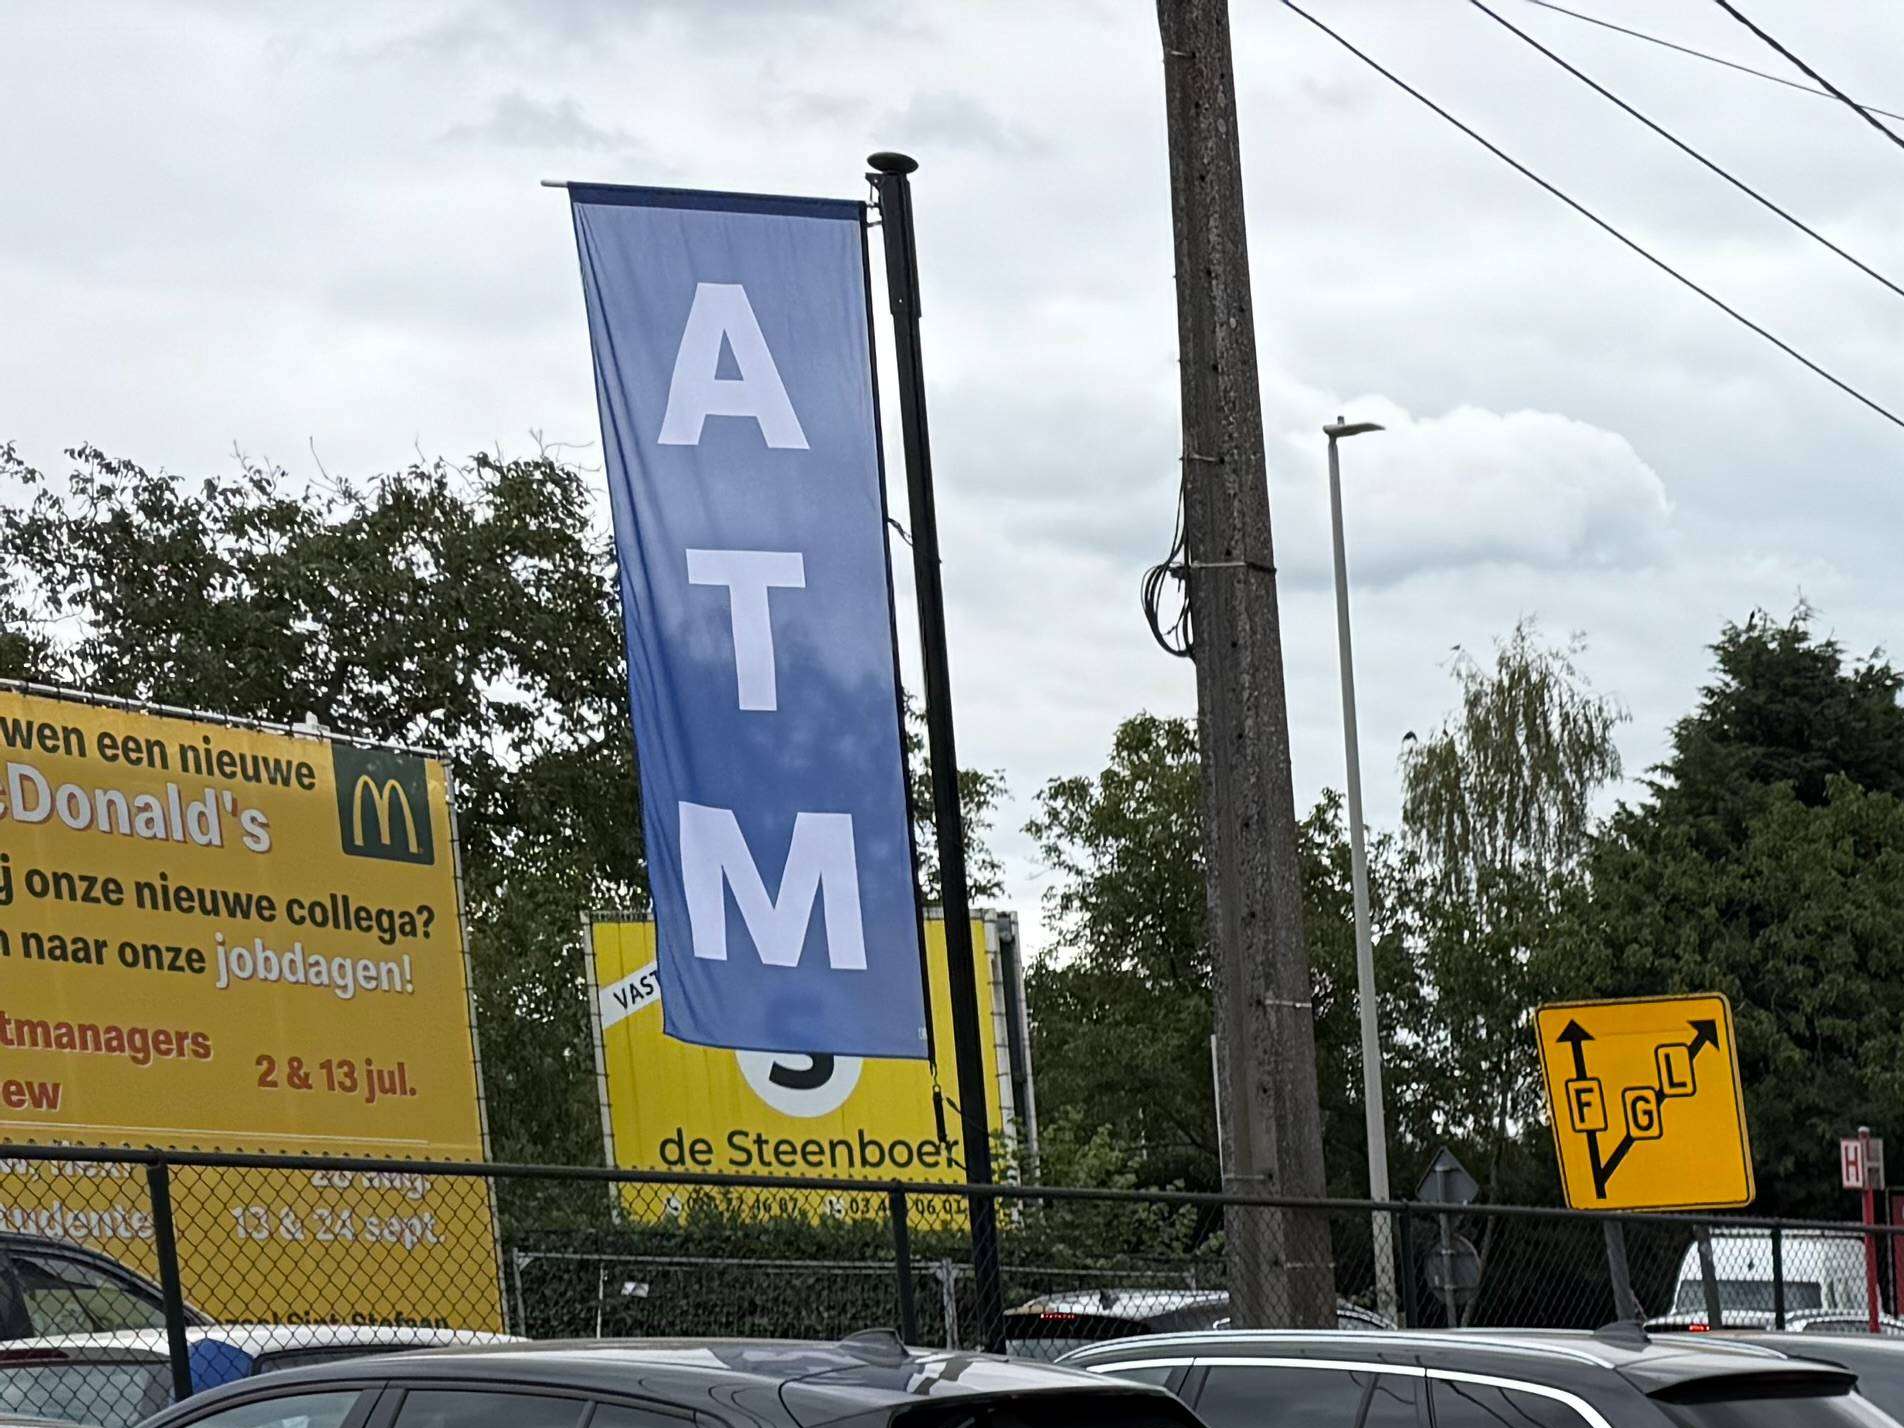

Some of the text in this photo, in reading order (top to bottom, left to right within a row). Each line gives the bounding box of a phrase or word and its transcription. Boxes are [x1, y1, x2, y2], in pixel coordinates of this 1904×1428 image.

[97, 730, 168, 771] een
[179, 735, 317, 792] nieuwe
[0, 760, 272, 855] Donald's
[24, 867, 125, 907] onze
[134, 872, 278, 924] nieuwe
[286, 893, 436, 946] collega?
[22, 930, 108, 965] naar
[117, 942, 207, 975] onze
[214, 931, 416, 1001] jobdagen!
[255, 1054, 279, 1090] 2
[286, 1056, 313, 1091] &
[319, 1058, 358, 1094] 13
[363, 1057, 418, 1105] jul.
[1664, 1053, 1687, 1089] L
[1574, 1087, 1594, 1123] F
[1631, 1095, 1654, 1131] G
[659, 1127, 960, 1169] de Steenboer
